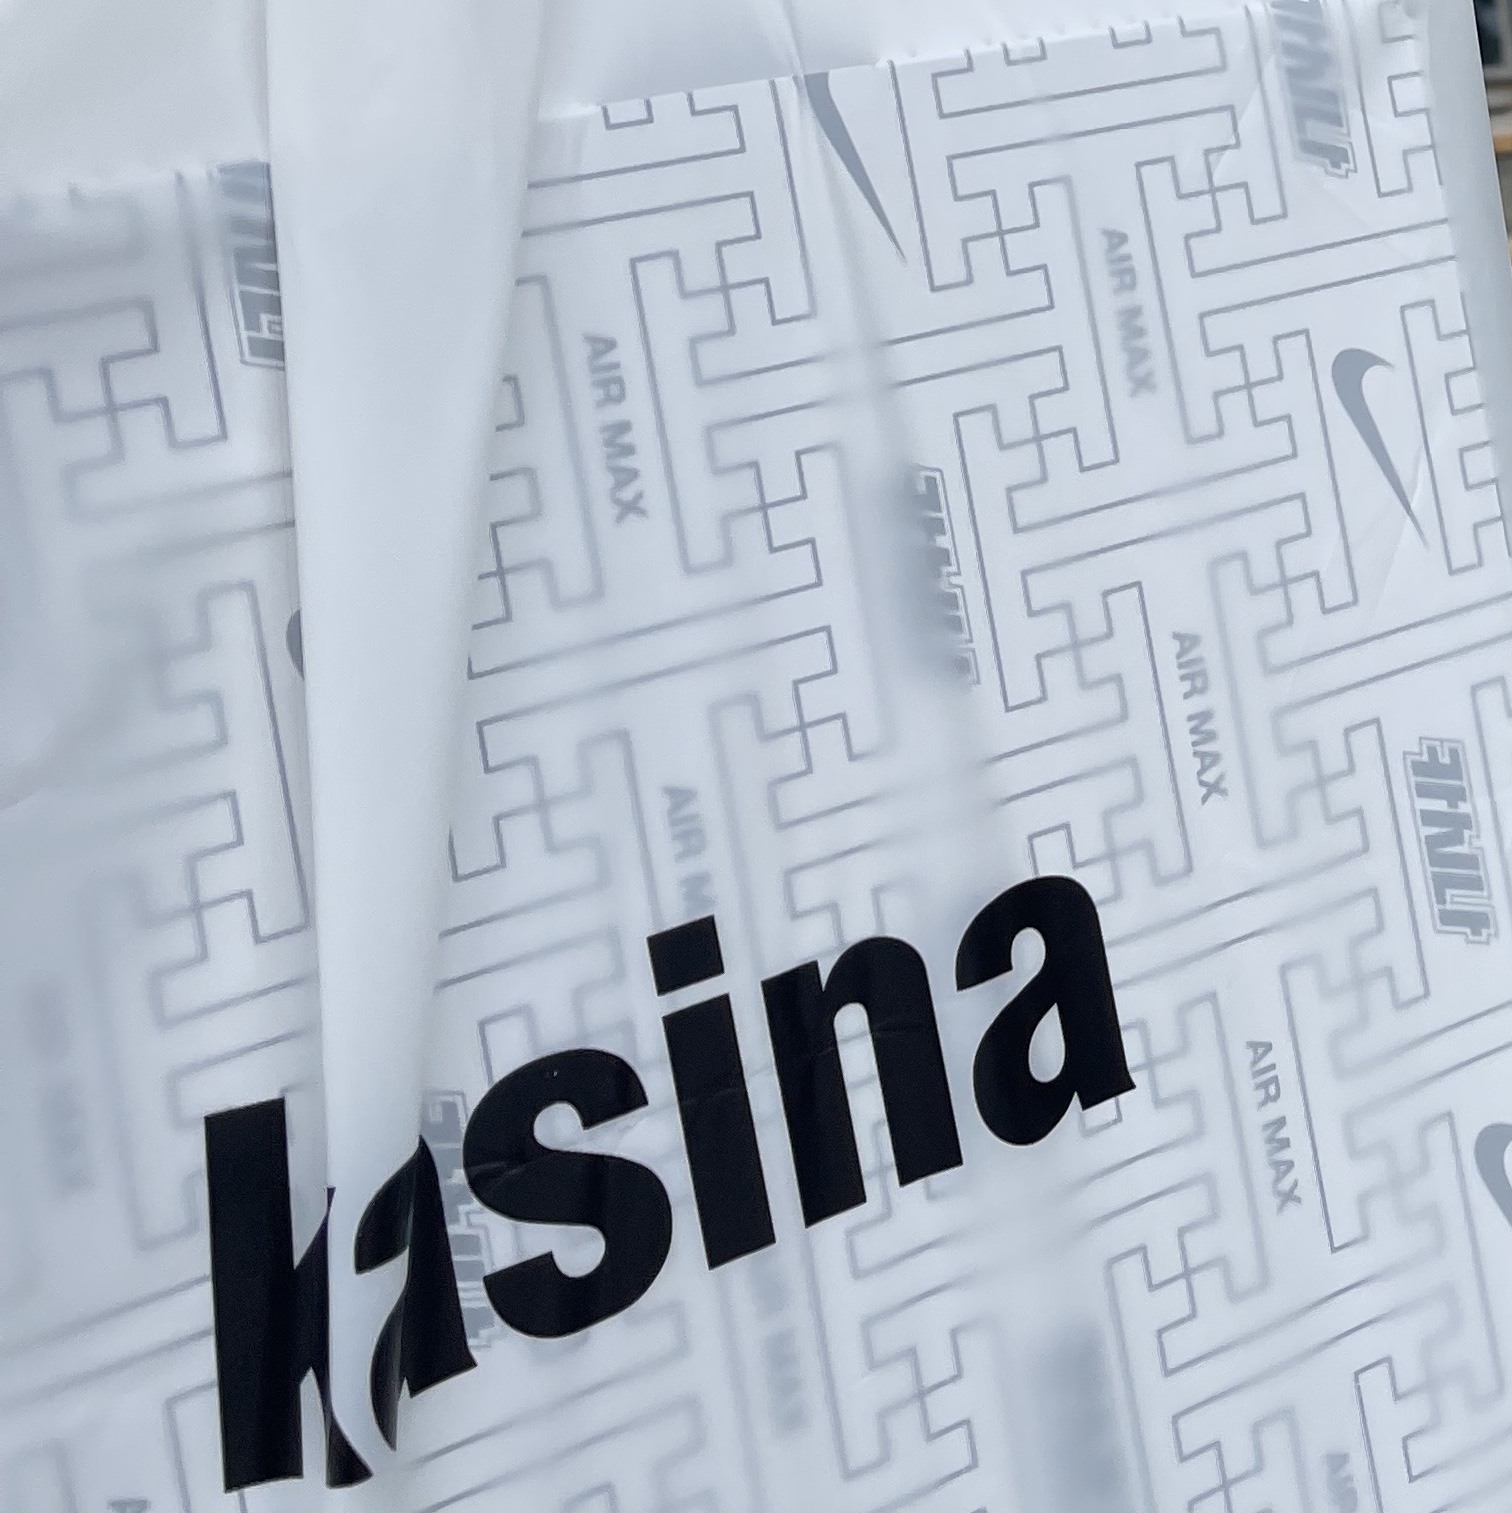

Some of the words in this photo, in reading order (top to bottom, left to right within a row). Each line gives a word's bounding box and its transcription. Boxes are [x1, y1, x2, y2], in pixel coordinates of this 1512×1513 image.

[1100, 228, 1137, 294] AIR
[582, 332, 624, 407] AIR
[1115, 304, 1156, 397] MAX
[600, 420, 648, 524] MAX
[1171, 630, 1209, 700] AIR
[1186, 711, 1229, 805] MAX
[662, 785, 707, 859] AIR
[1245, 1040, 1280, 1107] AIR
[204, 877, 1135, 1492] kasina
[1261, 1122, 1302, 1215] MAX
